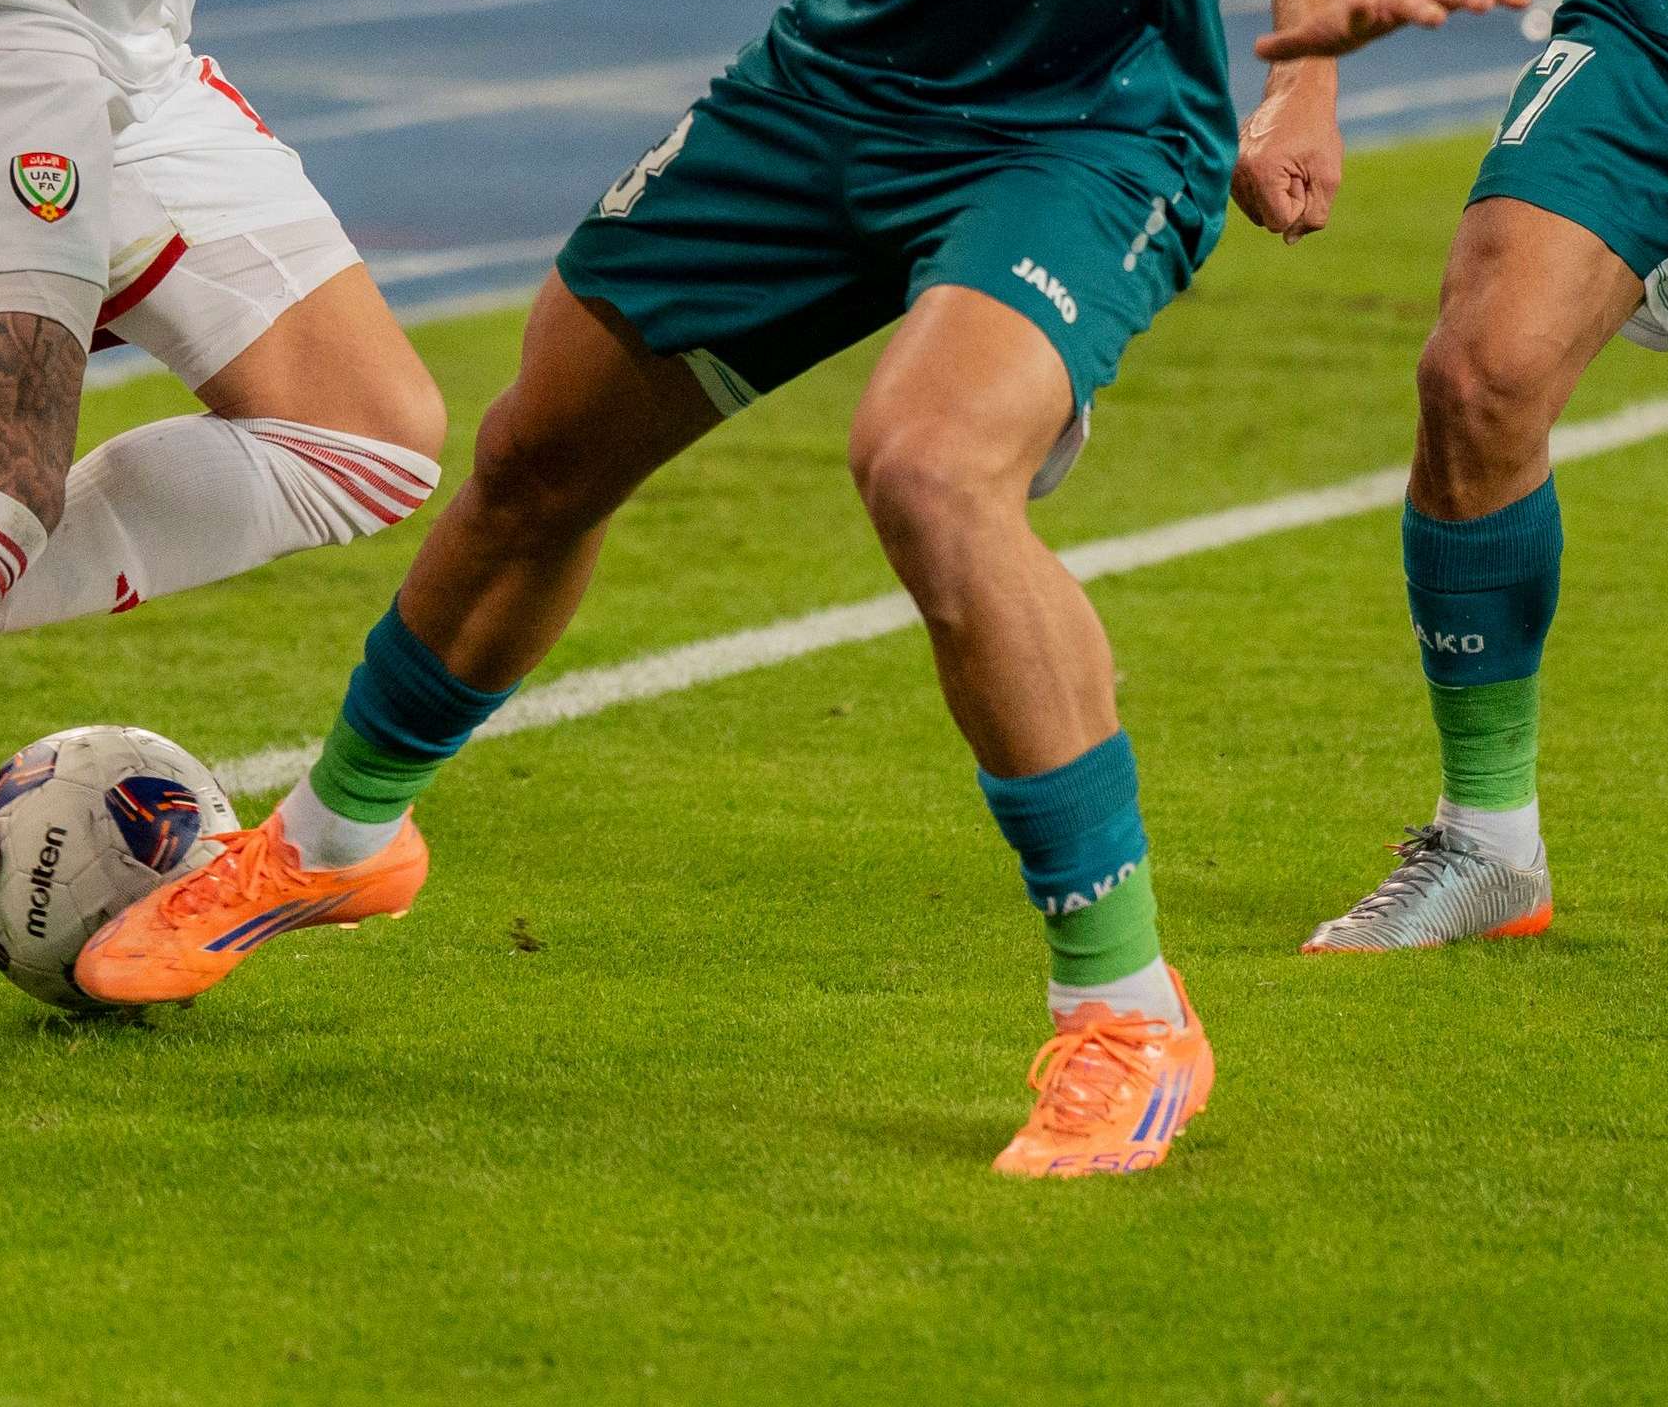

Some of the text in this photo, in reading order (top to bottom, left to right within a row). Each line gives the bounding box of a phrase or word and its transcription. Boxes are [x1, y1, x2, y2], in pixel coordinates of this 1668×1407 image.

[30, 171, 61, 182] UAE
[39, 182, 55, 191] FA
[1012, 257, 1077, 324] JAKO
[27, 826, 67, 938] molten
